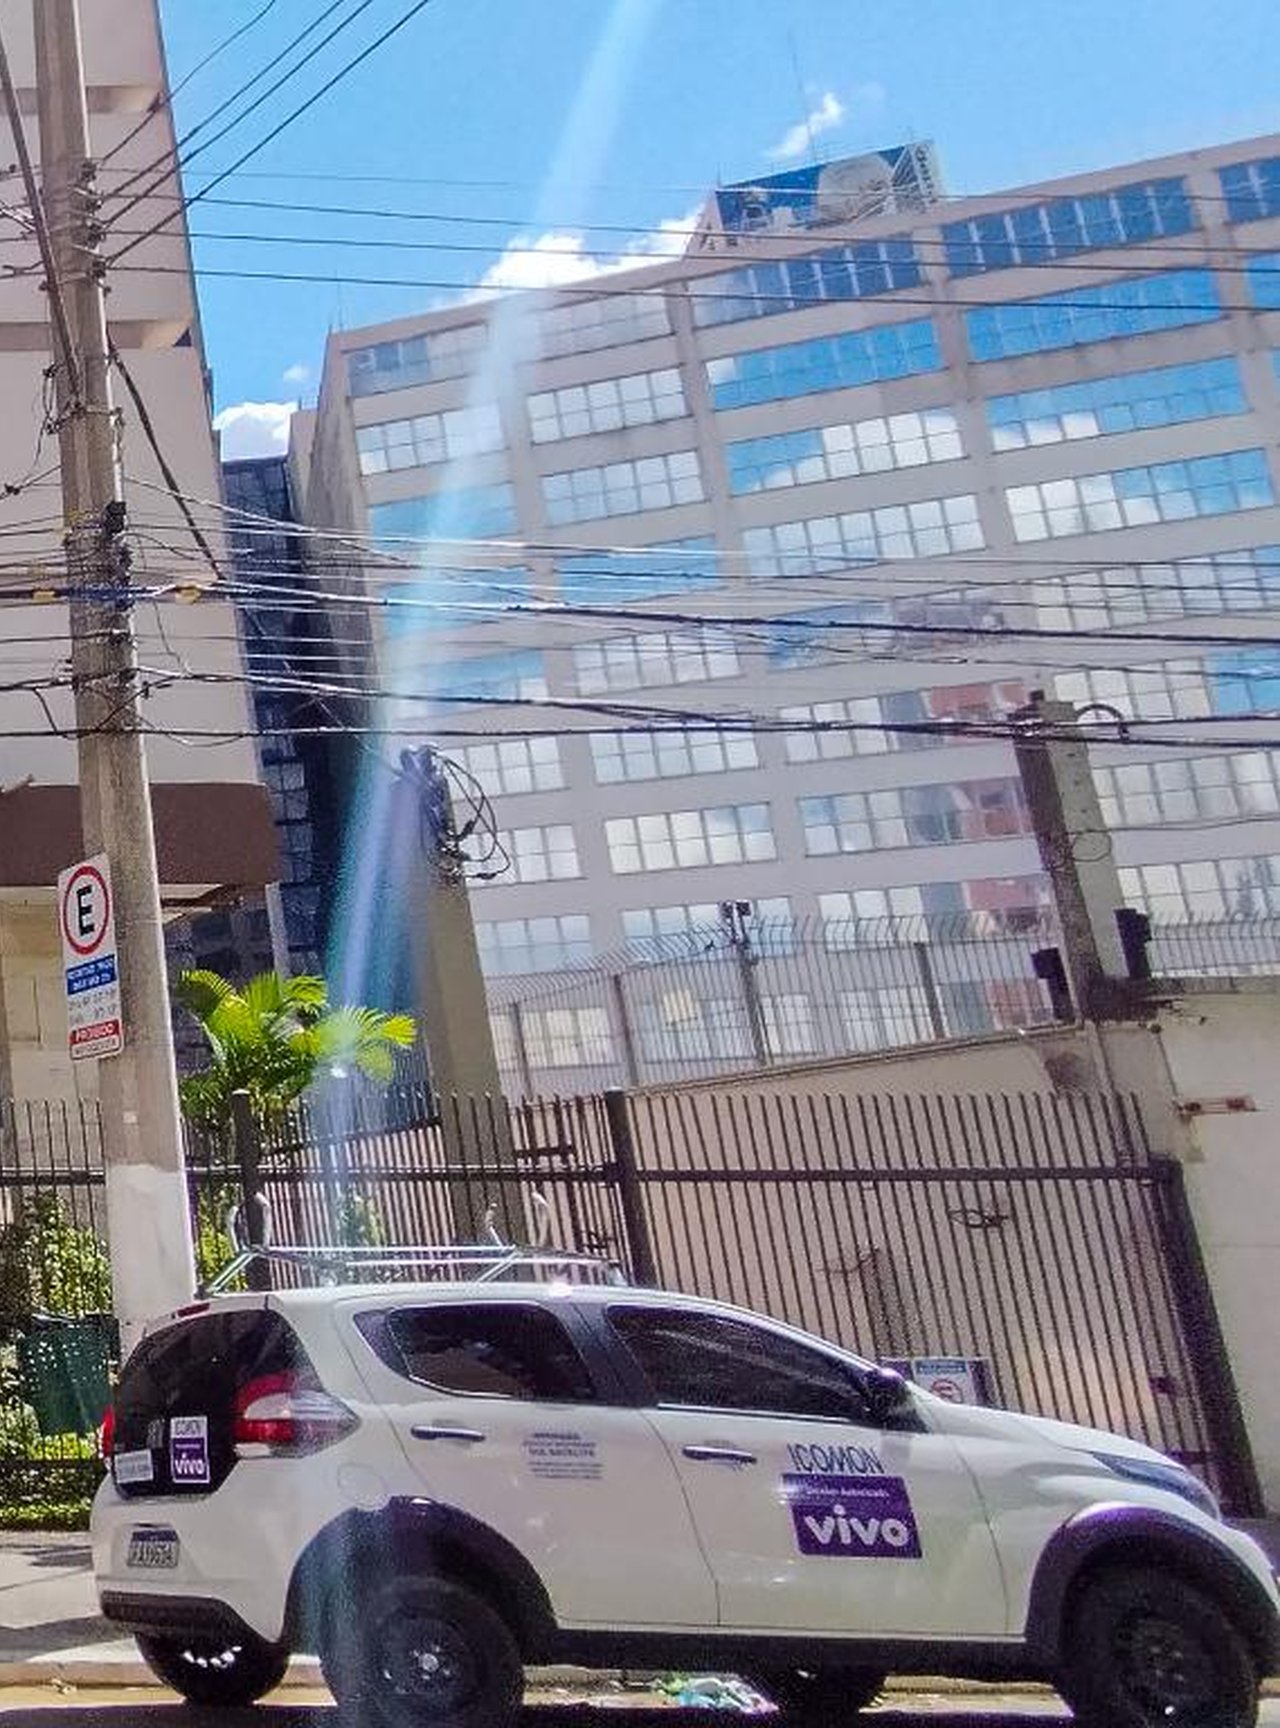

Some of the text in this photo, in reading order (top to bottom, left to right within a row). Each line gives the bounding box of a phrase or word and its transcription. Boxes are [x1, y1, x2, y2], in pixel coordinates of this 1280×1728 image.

[76, 884, 95, 937] E
[175, 1453, 206, 1475] vivo
[786, 1443, 885, 1474] ICOMON
[804, 1504, 909, 1547] vivo
